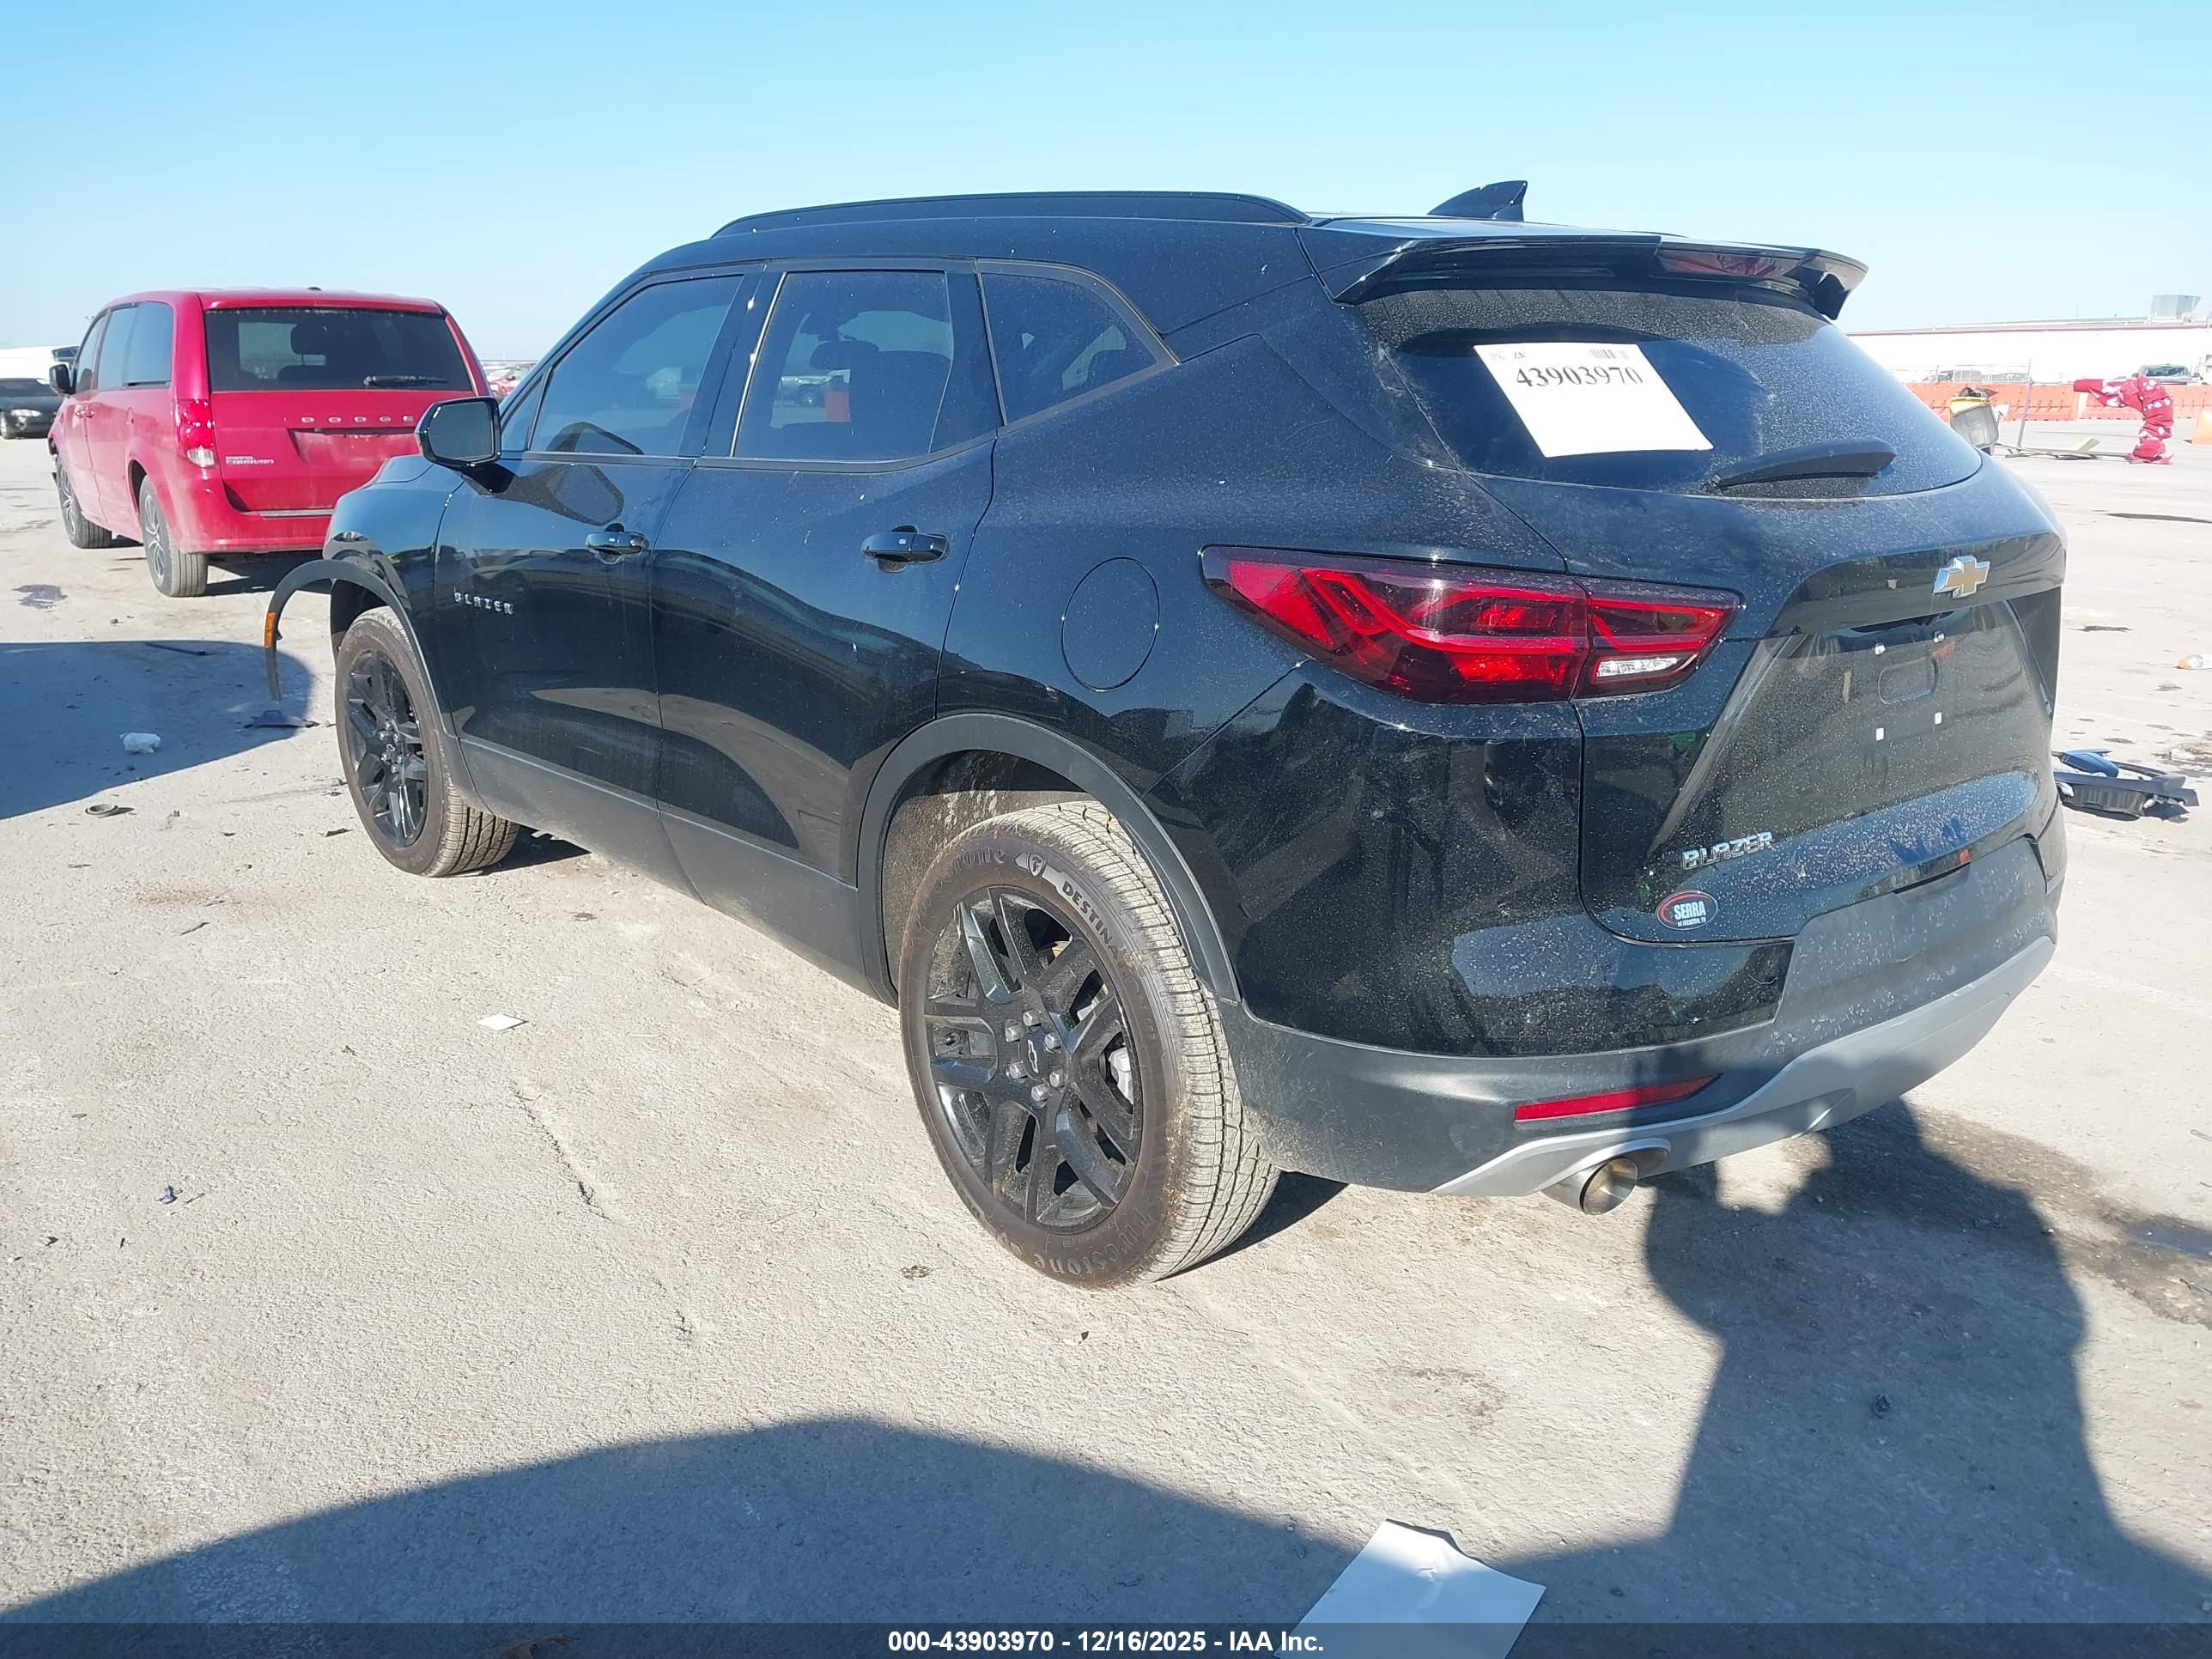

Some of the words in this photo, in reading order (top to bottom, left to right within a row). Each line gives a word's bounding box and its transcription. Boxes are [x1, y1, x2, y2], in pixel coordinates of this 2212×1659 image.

[1516, 366, 1644, 386] 43903970
[453, 592, 514, 615] BLAZER
[1683, 831, 1775, 870] BLAZER
[1674, 900, 1707, 921] SERRA
